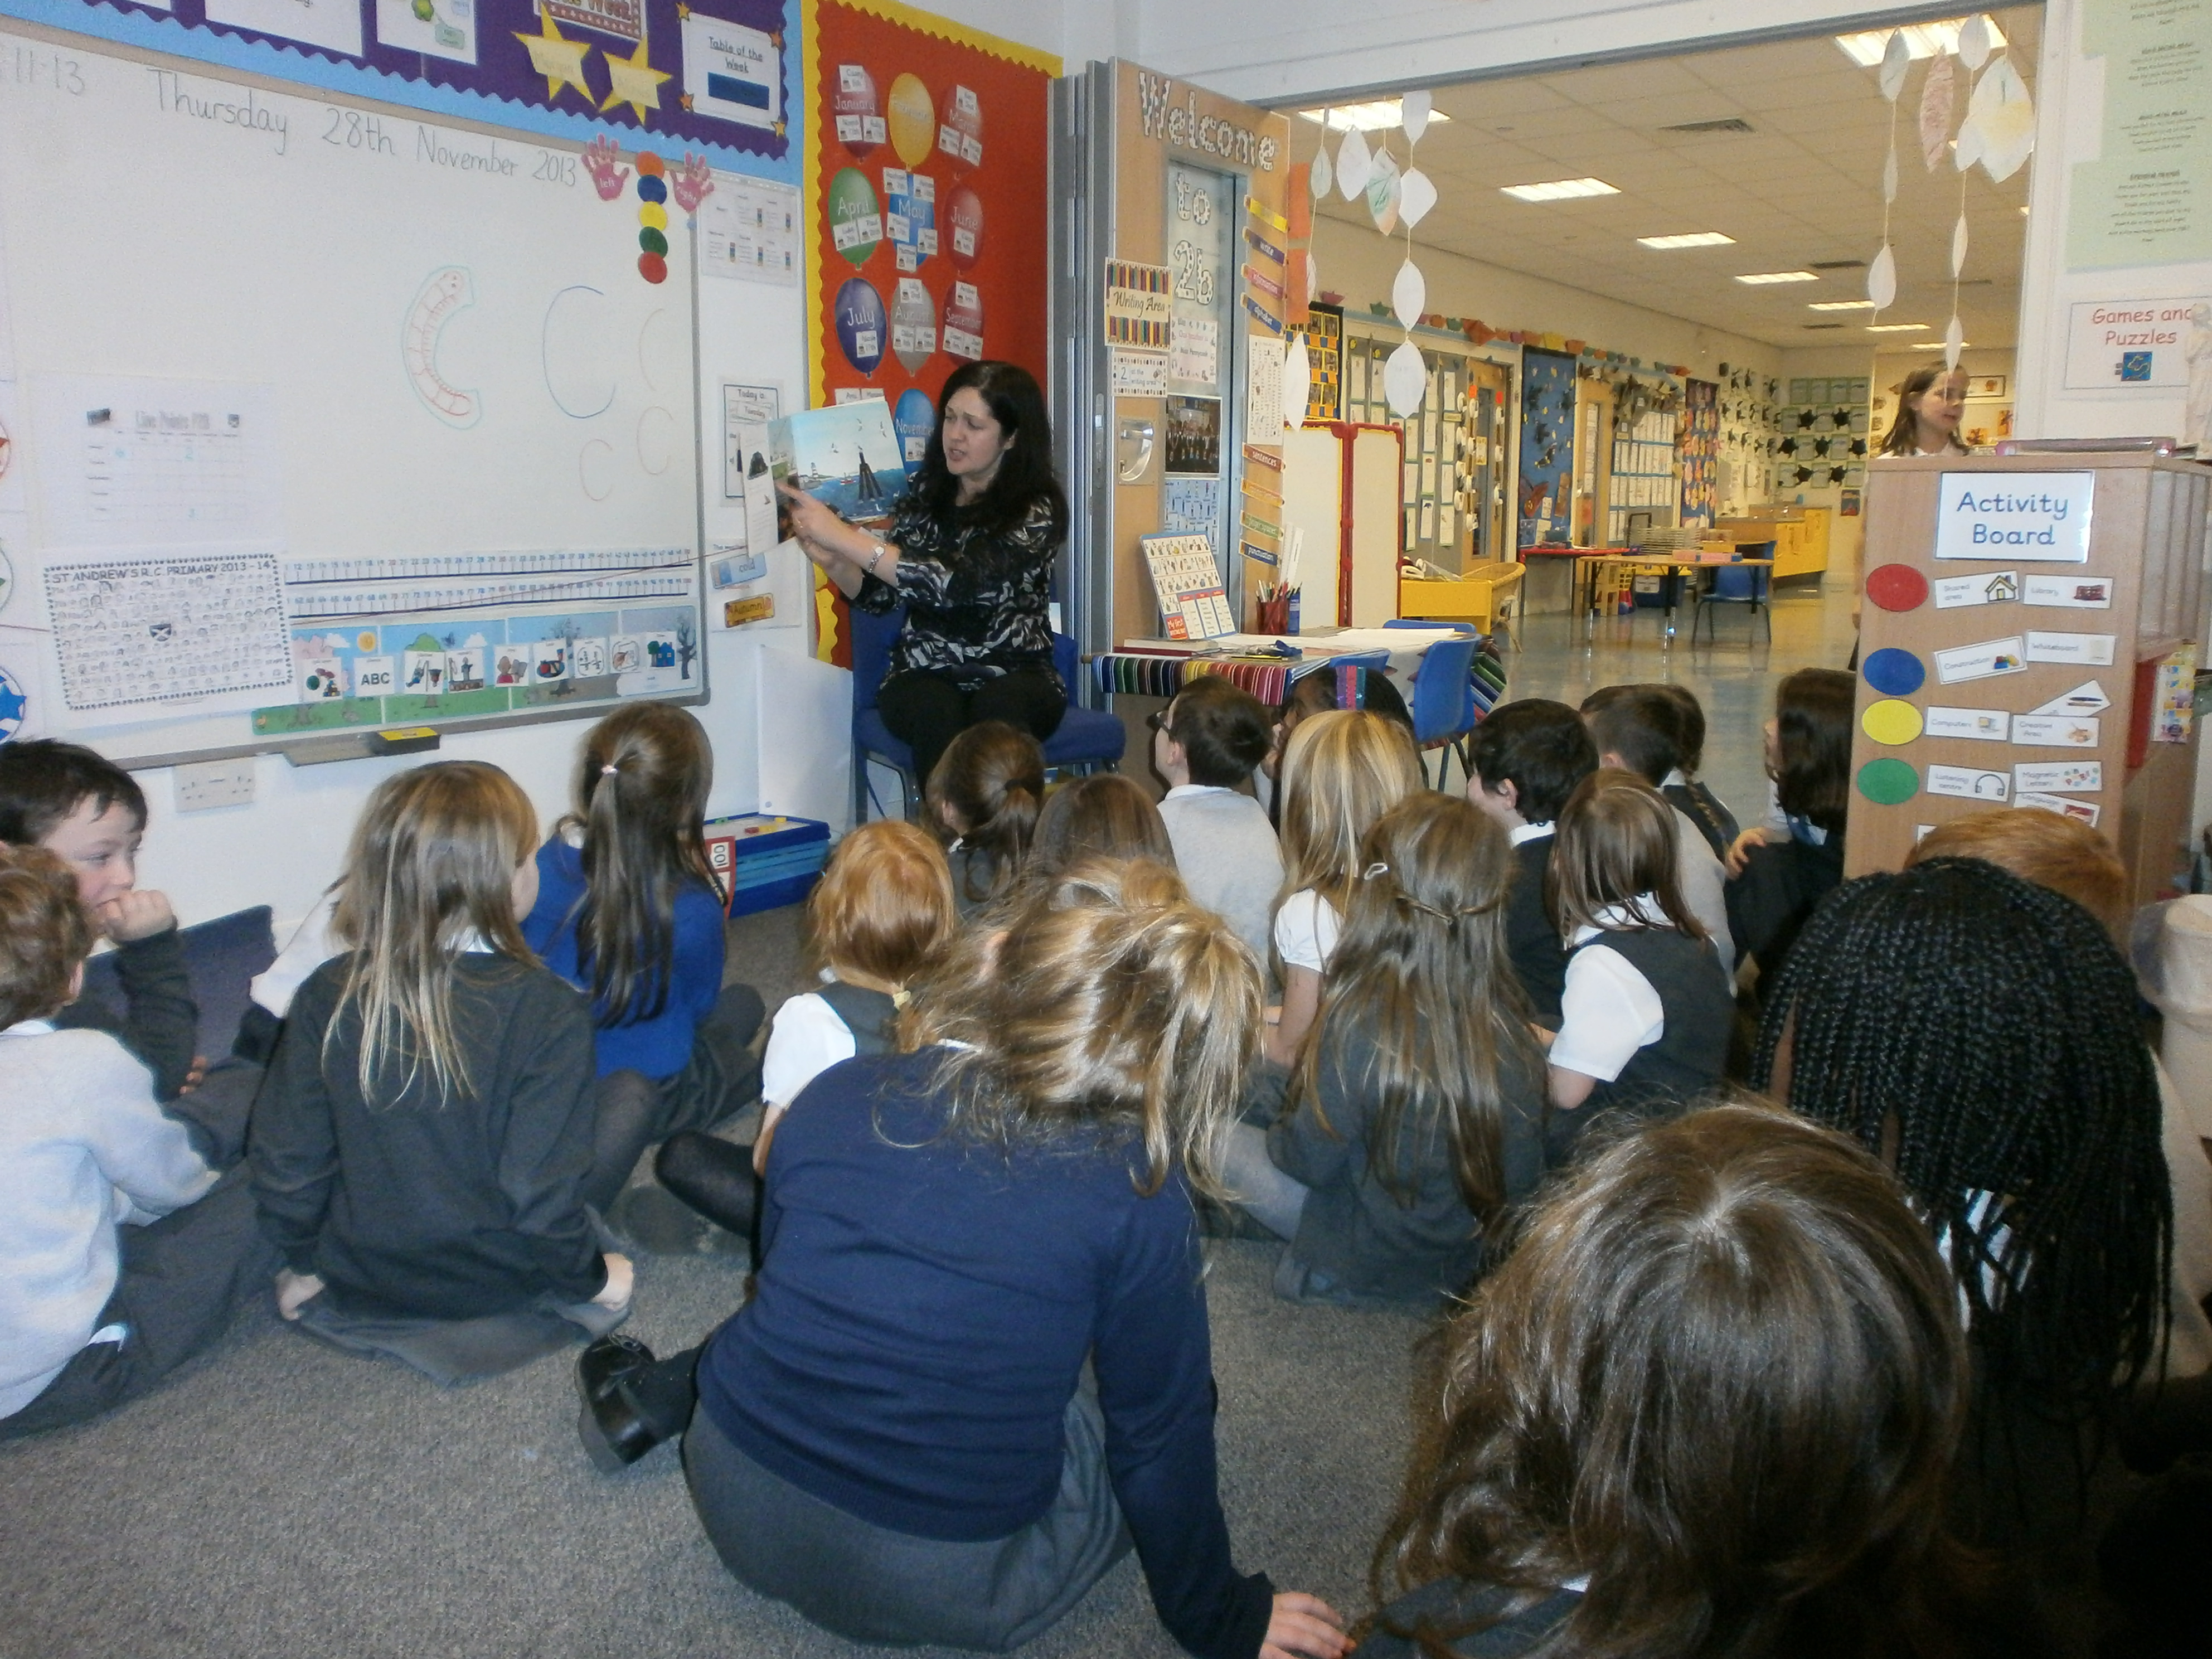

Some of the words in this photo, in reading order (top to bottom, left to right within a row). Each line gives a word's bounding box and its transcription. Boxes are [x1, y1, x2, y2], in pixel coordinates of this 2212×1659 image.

[709, 36, 734, 53] Table
[736, 46, 745, 55] of
[748, 48, 763, 60] the
[725, 57, 749, 73] Week
[836, 95, 875, 115] January
[147, 69, 287, 156] Thursday
[322, 108, 395, 155] 28th
[417, 125, 519, 176] November
[532, 149, 577, 187] 2013
[1139, 71, 1275, 171] Welcome
[838, 196, 869, 220] April
[1176, 172, 1211, 225] to
[899, 198, 926, 227] May
[951, 206, 978, 230] June
[1173, 240, 1214, 305] 2b
[1113, 292, 1144, 318] Writing
[1146, 297, 1166, 312] Area
[2092, 308, 2154, 324] Games
[847, 306, 876, 329] July
[2106, 328, 2177, 346] Puzzles
[1120, 366, 1128, 380] 2
[738, 389, 757, 401] Today
[896, 418, 935, 437] November
[1253, 451, 1277, 467] sentences
[1957, 491, 2069, 520] Activity
[1973, 523, 2056, 545] Board
[52, 573, 70, 584] ST
[167, 564, 219, 575] PRIMARY
[221, 561, 246, 572] 2013
[258, 560, 270, 570] 14
[739, 558, 756, 573] cold
[734, 602, 763, 613] Autumn
[361, 672, 390, 686] ABC
